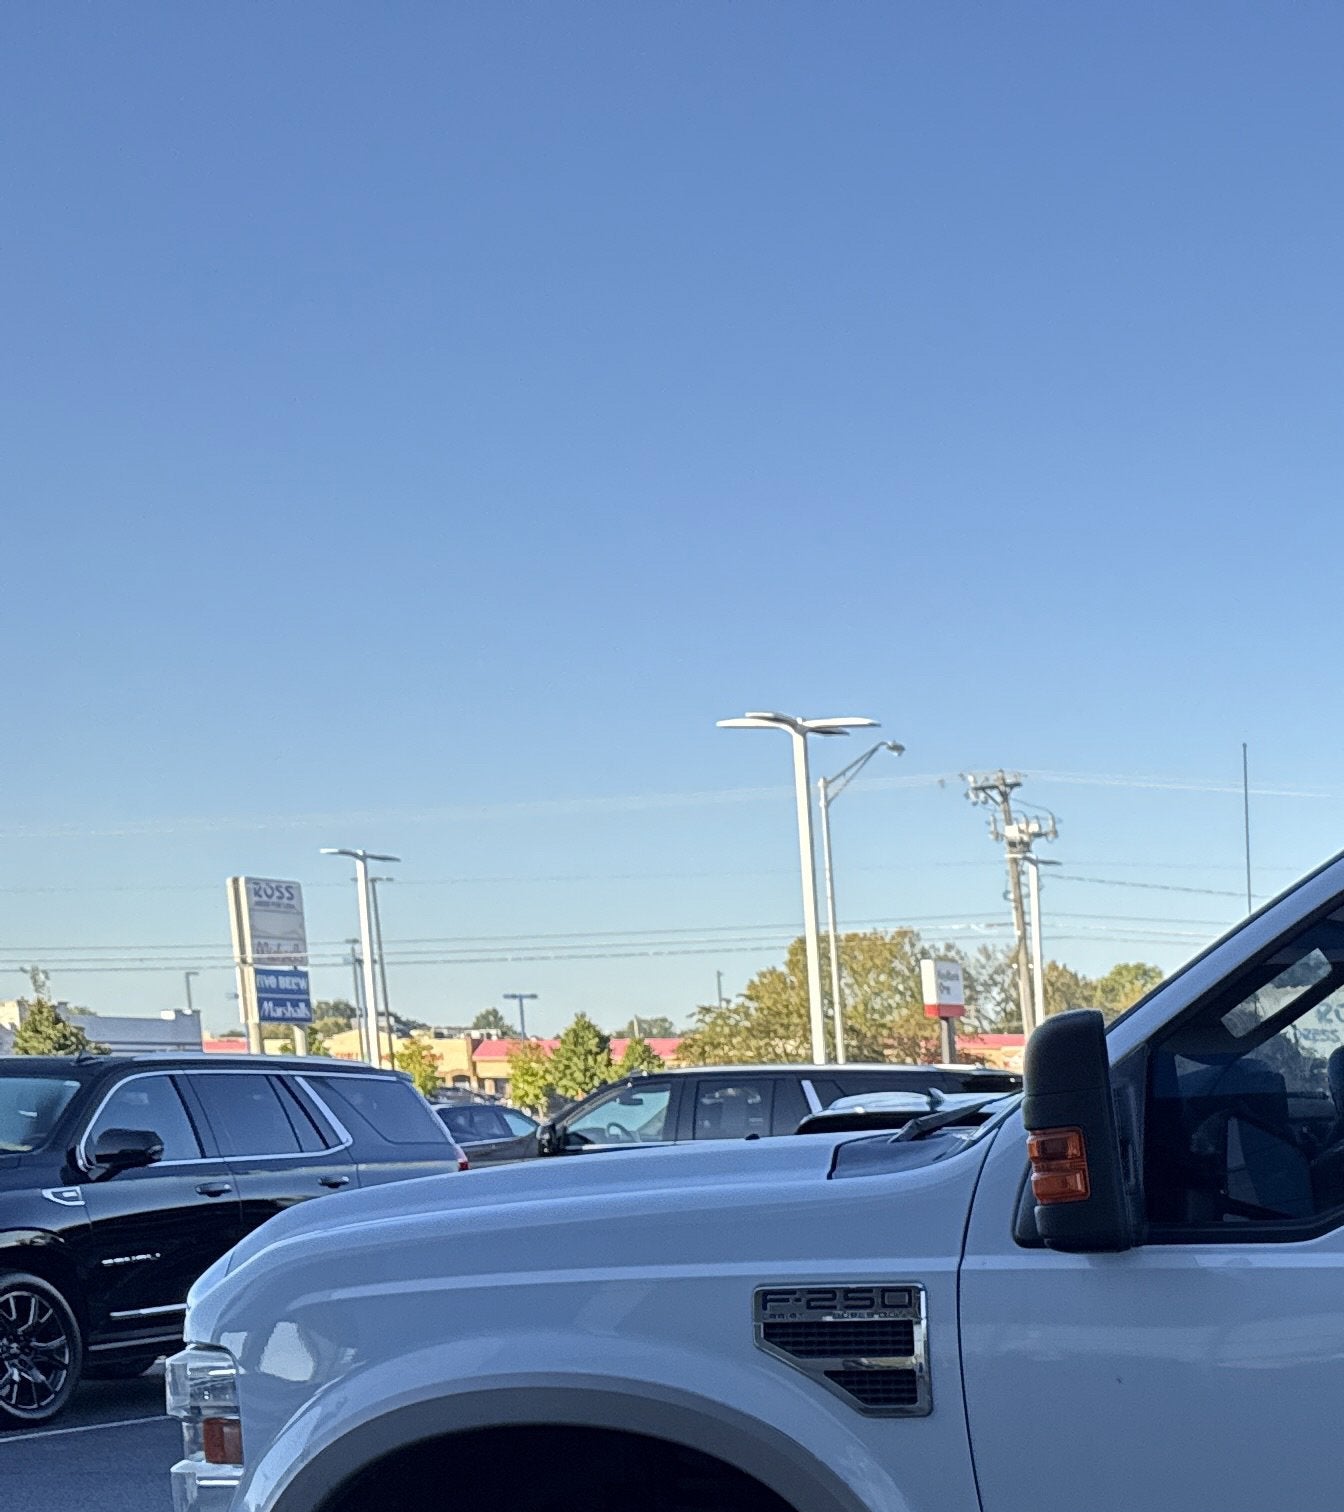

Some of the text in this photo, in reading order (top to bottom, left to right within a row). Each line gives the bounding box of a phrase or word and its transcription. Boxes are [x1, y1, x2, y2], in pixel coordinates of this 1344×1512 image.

[252, 882, 295, 901] ROSS
[260, 1000, 311, 1018] Marshalls
[761, 1288, 913, 1311] F-250
